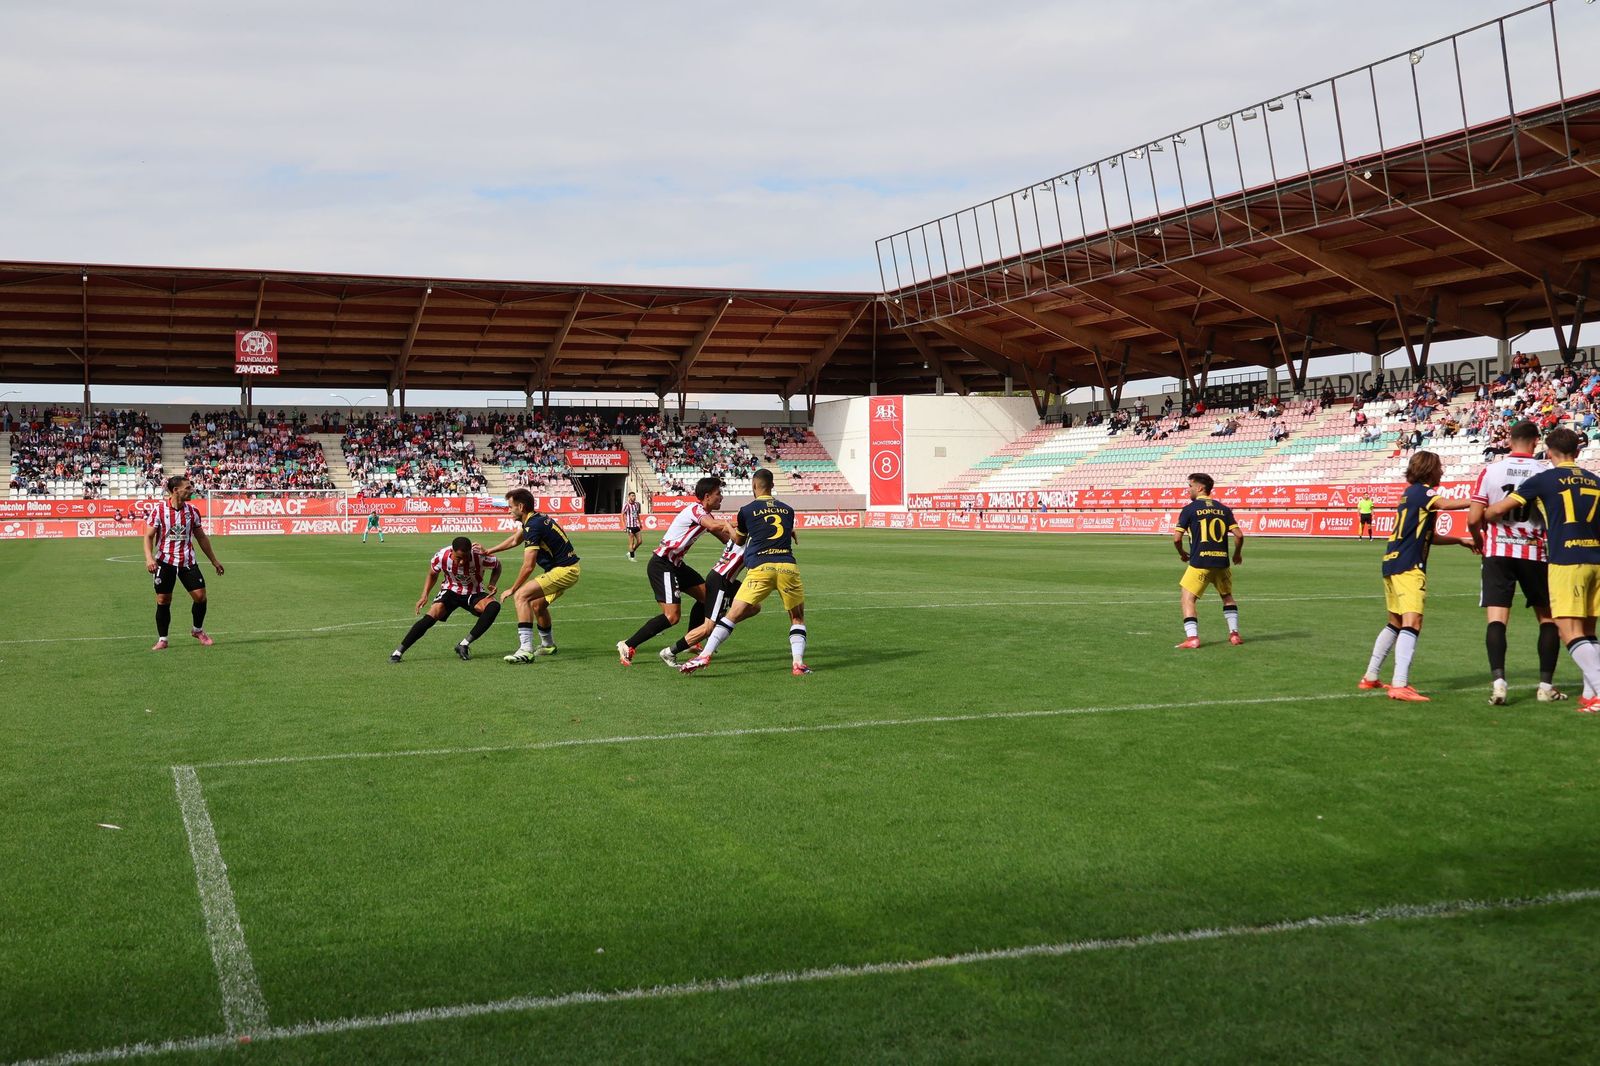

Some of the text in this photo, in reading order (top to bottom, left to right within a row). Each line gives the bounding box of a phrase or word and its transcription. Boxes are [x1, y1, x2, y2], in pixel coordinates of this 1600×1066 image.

[240, 355, 273, 363] FUNDACIÓN
[881, 457, 892, 474] 8
[1558, 476, 1597, 487] VÍCTOR
[553, 499, 558, 507] 8
[575, 499, 580, 507] 8
[988, 492, 1015, 508] ZAMORA
[1016, 492, 1026, 508] CF
[1347, 492, 1387, 504] Gonález
[223, 499, 308, 516] ZAMORA CF
[408, 499, 428, 508] fisio
[1558, 487, 1600, 525] 17
[752, 507, 789, 517] LANCHO
[115, 521, 132, 529] Joven
[441, 517, 483, 525] PERSIANAS
[803, 514, 859, 527] ZAMORA CF
[1267, 519, 1308, 531] INNOVA Chef
[1326, 517, 1353, 526] VERSUS
[229, 521, 283, 531] Sumiller
[291, 520, 359, 533] ZAMORA CF
[382, 525, 420, 533] ZAMORA
[431, 524, 483, 533] ZAMORANAS
[763, 514, 784, 540] 3
[1199, 517, 1226, 543] 10
[124, 529, 138, 537] León
